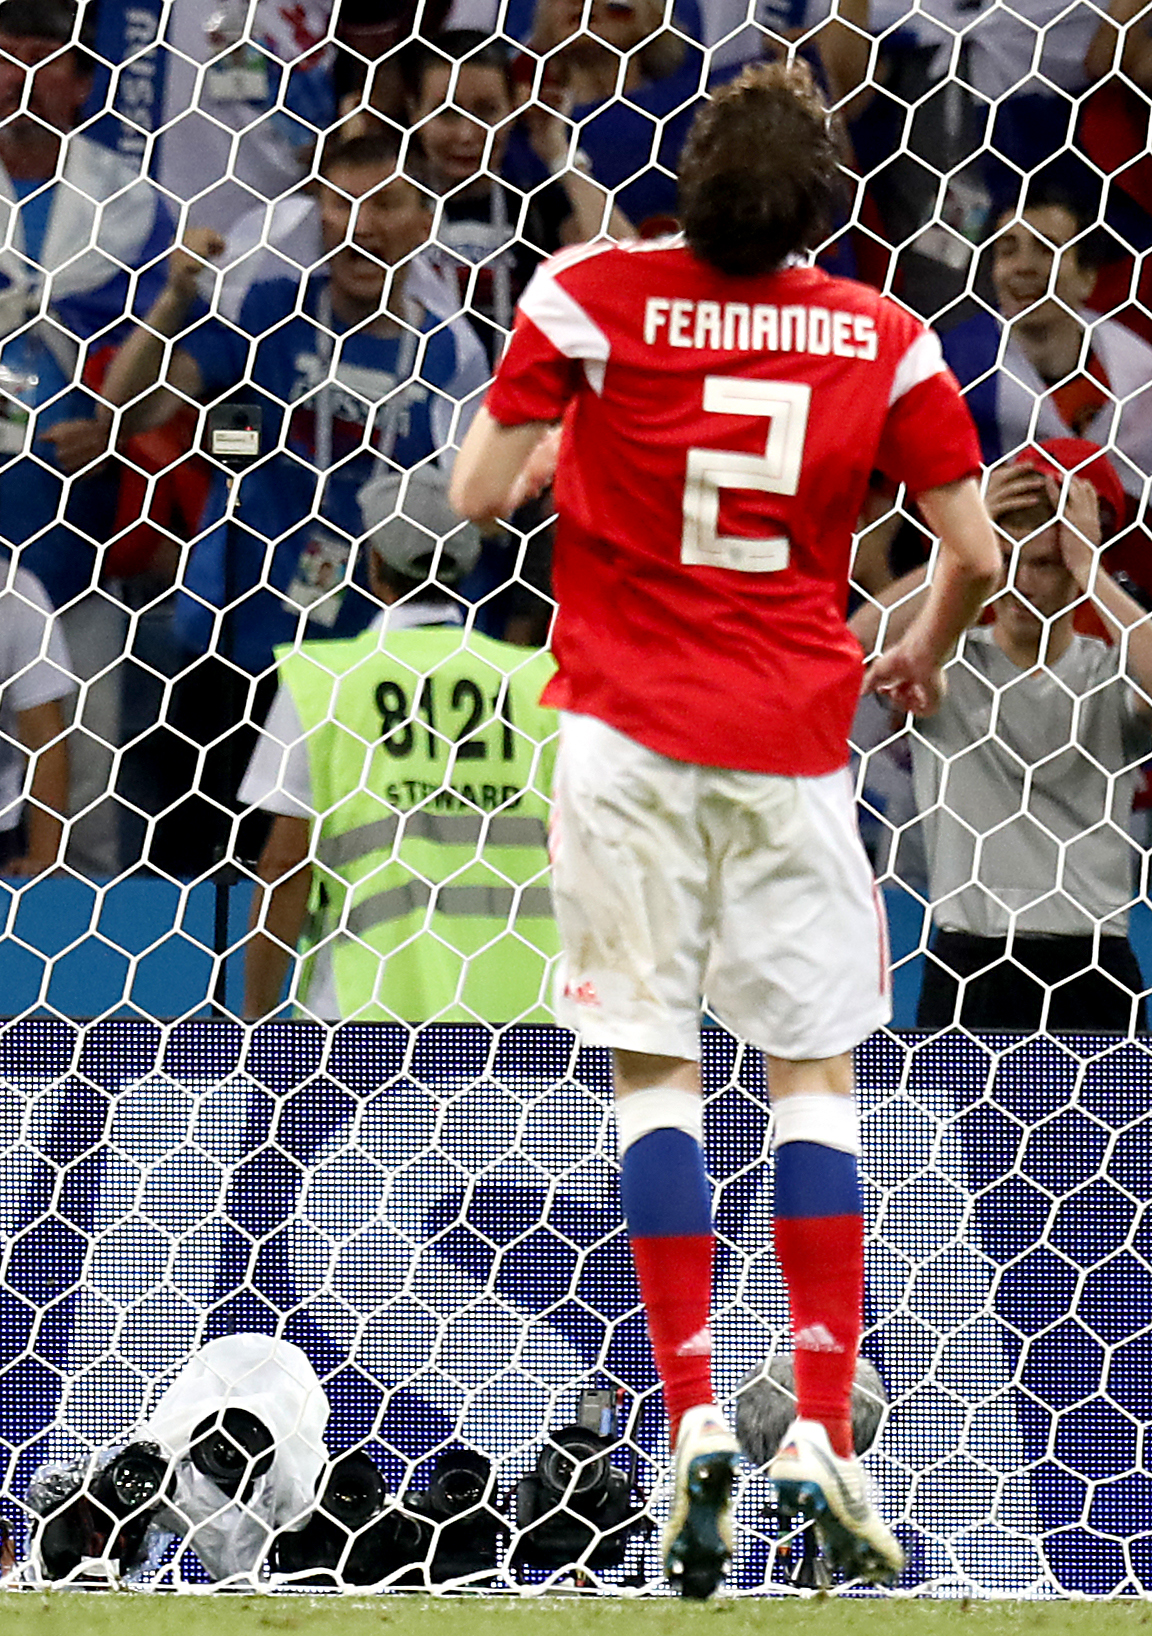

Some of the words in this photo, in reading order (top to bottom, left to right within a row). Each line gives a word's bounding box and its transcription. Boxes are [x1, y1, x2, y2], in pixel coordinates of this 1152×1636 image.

[643, 297, 878, 361] FERNANDES
[680, 375, 812, 573] 2
[375, 676, 515, 760] 8121
